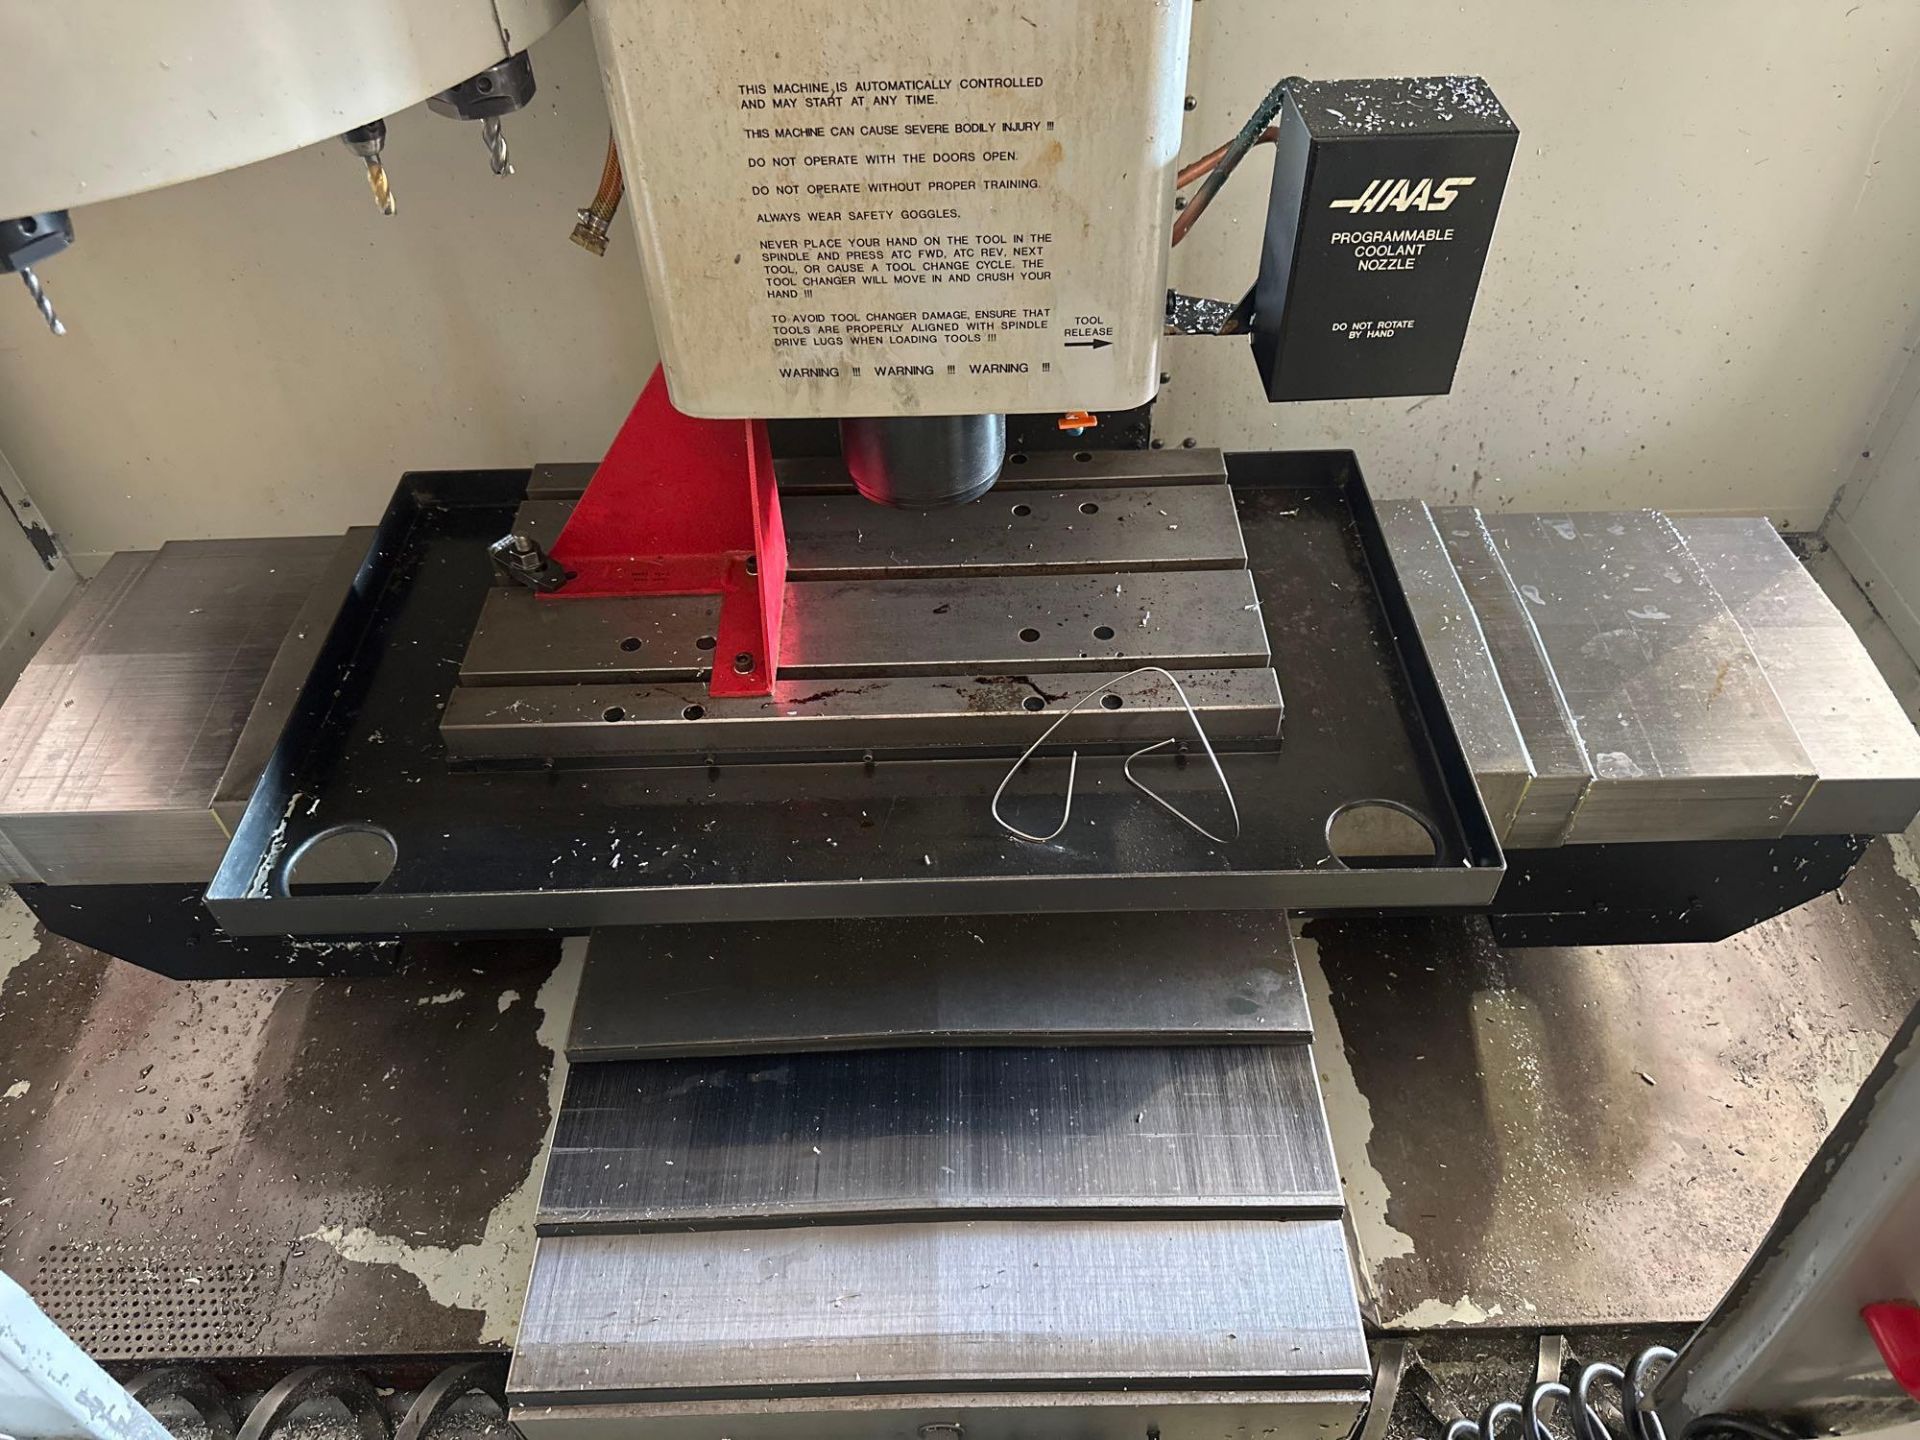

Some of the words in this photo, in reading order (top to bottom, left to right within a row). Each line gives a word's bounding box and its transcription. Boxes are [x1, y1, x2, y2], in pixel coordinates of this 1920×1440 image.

[738, 84, 767, 96] THIS
[773, 82, 829, 94] MACHINE
[836, 82, 848, 93] IS
[855, 79, 952, 92] AUTOMATICALLY
[960, 77, 1043, 90] CONTROLLED
[741, 99, 766, 110] AND
[773, 98, 797, 109] MAY
[805, 96, 842, 108] START
[851, 96, 865, 107] AT
[873, 95, 898, 107] ANY
[905, 94, 938, 105] TIME.
[745, 128, 770, 139] THIS
[775, 126, 825, 138] MACHINE
[830, 126, 855, 137] CAN
[860, 124, 899, 136] CAUSE
[904, 123, 950, 135] SEVERE
[955, 122, 996, 134] BODILY
[1002, 121, 1041, 132] INJURY
[748, 157, 766, 168] DO
[772, 156, 796, 167] NOT
[804, 154, 858, 166] OPERATE
[865, 154, 896, 165] WITH
[903, 153, 926, 164] THE
[933, 152, 976, 163] DOORS
[982, 151, 1018, 162] OPEN.
[752, 185, 769, 196] DO
[776, 184, 800, 195] NOT
[807, 183, 861, 195] OPERATE
[868, 182, 922, 193] WITHOUT
[928, 180, 976, 191] PROPER
[984, 179, 1041, 190] TRAINING.
[1329, 177, 1476, 213] HAAS
[757, 212, 801, 223] ALWAYS
[807, 211, 842, 222] WEAR
[848, 210, 894, 221] SAFETY
[901, 209, 961, 220] GOGGLES.
[759, 239, 799, 250] NEVER
[804, 239, 842, 249] PLACE
[848, 237, 881, 248] YOUR
[886, 236, 918, 247] HAND
[924, 236, 941, 246] ON
[947, 235, 970, 245] THE
[976, 234, 1007, 245] TOOL
[1013, 234, 1024, 243] IN
[1030, 233, 1052, 243] THE
[1331, 229, 1454, 244] PROGRAMMABLE
[762, 251, 811, 262] SPINDLE
[817, 250, 840, 261] AND
[846, 249, 884, 260] PRESS
[891, 249, 912, 259] ATC
[918, 249, 947, 259] FWD,
[954, 248, 975, 258] ATC
[980, 247, 1008, 258] REV,
[1013, 246, 1044, 257] NEXT
[1355, 244, 1425, 257] COOLANT
[764, 264, 798, 275] TOOL,
[804, 264, 821, 274] OR
[826, 263, 864, 273] CAUSE
[871, 262, 879, 272] A
[885, 261, 917, 272] TOOL
[922, 260, 970, 271] CHANGE
[975, 259, 1015, 270] CYCLE.
[1022, 259, 1044, 269] THE
[1357, 258, 1415, 271] NOZZLE
[766, 276, 798, 287] TOOL
[803, 275, 856, 286] CHANGER
[862, 274, 888, 285] WILL
[894, 274, 927, 284] MOVE
[932, 273, 943, 283] IN
[948, 272, 971, 283] AND
[976, 271, 1015, 282] CRUSH
[1020, 270, 1052, 281] YOUR
[767, 289, 799, 299] HAND
[772, 314, 788, 324] TO
[792, 313, 826, 324] AVOID
[830, 312, 861, 323] TOOL
[865, 310, 918, 322] CHANGER
[922, 309, 970, 321] DAMAGE,
[975, 309, 1018, 319] ENSURE
[1023, 308, 1051, 318] THAT
[1074, 315, 1104, 326] TOOL
[773, 325, 811, 336] TOOLS
[817, 324, 841, 335] ARE
[846, 322, 904, 334] PROPERLY
[910, 322, 959, 333] ALIGNED
[966, 321, 995, 331] WITH
[1001, 319, 1049, 330] SPINDLE
[1064, 326, 1114, 338] RELEASE
[1331, 322, 1347, 331] DO
[1352, 321, 1372, 330] NOT
[1377, 320, 1415, 329] ROTATE
[774, 336, 808, 347] DRIVE
[813, 335, 844, 346] LUGS
[850, 335, 884, 345] WHEN
[889, 334, 938, 344] LOADING
[944, 333, 982, 344] TOOLS
[1348, 330, 1361, 339] BY
[1367, 329, 1394, 337] HAND
[779, 366, 839, 379] WARNING
[874, 365, 934, 377] WARNING
[969, 362, 1029, 374] WARNING
